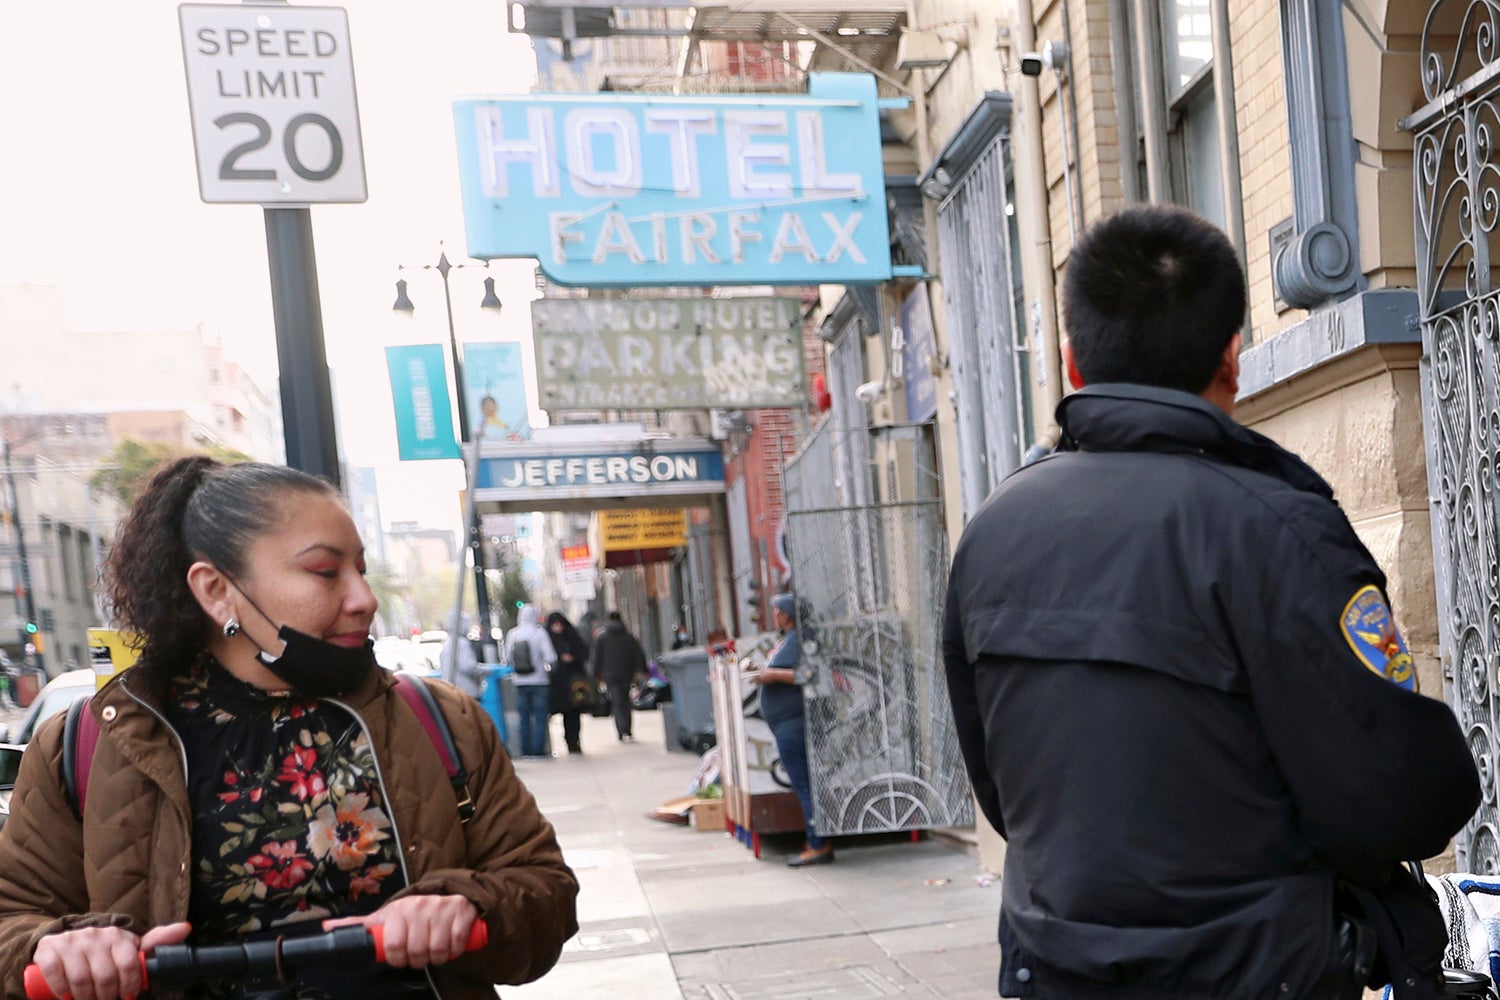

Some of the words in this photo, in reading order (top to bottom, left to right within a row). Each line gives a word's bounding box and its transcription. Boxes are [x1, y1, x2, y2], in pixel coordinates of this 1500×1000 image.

[197, 28, 337, 57] SPEED
[216, 69, 324, 98] LIMIT
[212, 112, 343, 181] 20
[474, 105, 863, 199] HOTEL
[549, 211, 868, 264] FAIRFAX
[541, 335, 800, 376] PARKING
[503, 455, 697, 487] JEFFERSON
